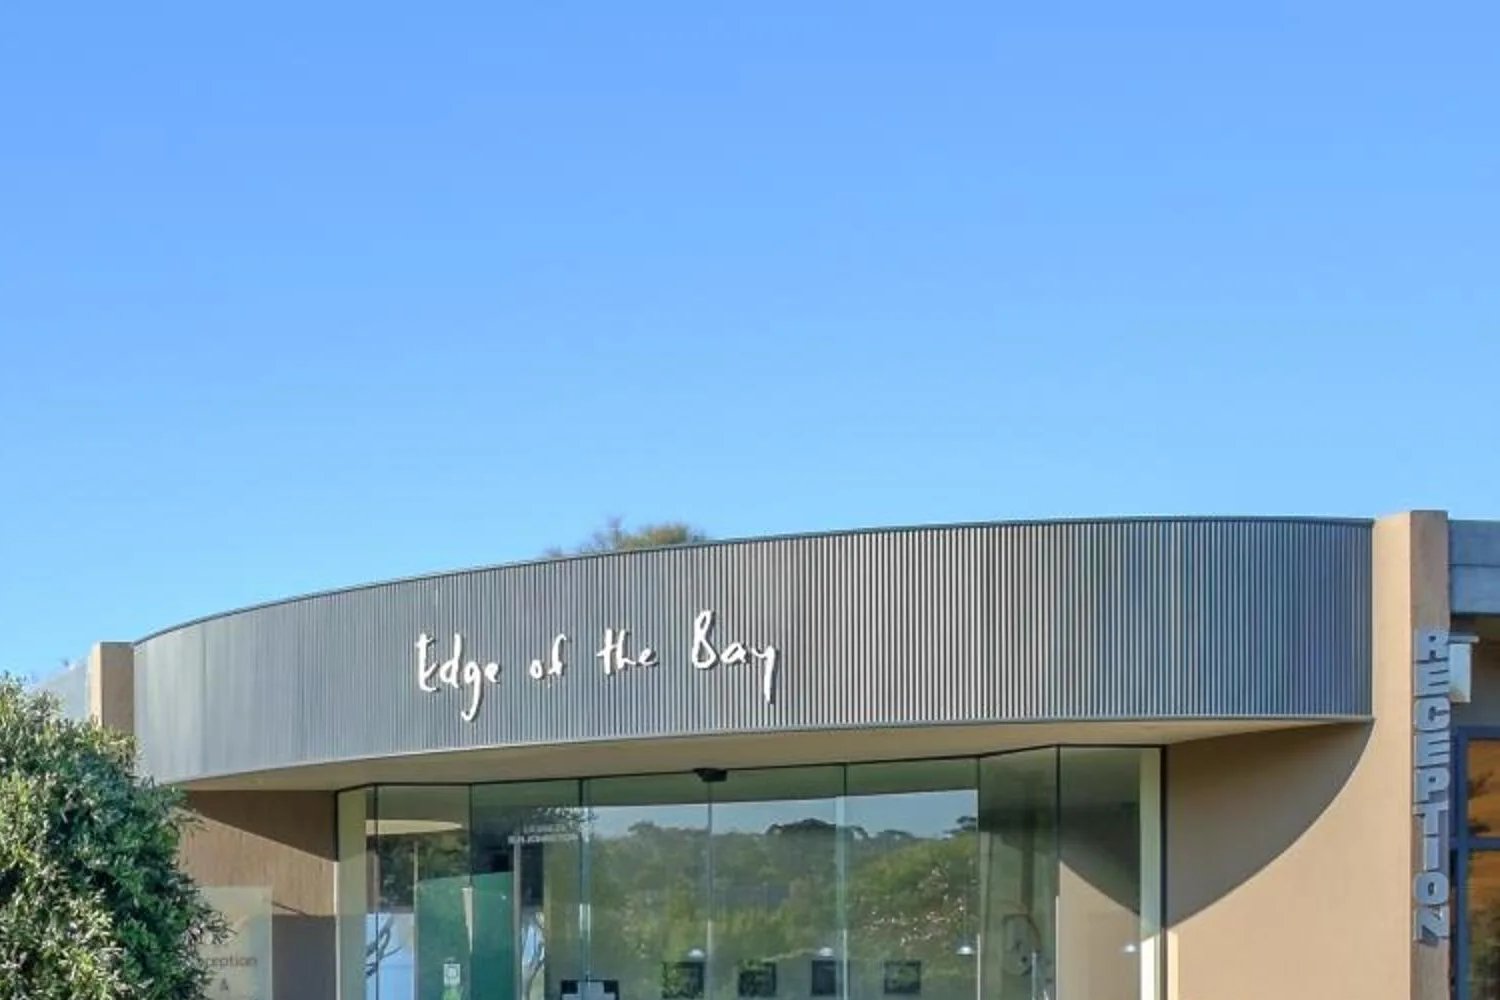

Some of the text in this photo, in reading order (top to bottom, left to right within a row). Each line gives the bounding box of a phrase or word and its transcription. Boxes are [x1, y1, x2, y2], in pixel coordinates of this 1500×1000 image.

[416, 609, 779, 721] Edge of the Bay
[1412, 627, 1449, 947] RECEPTION
